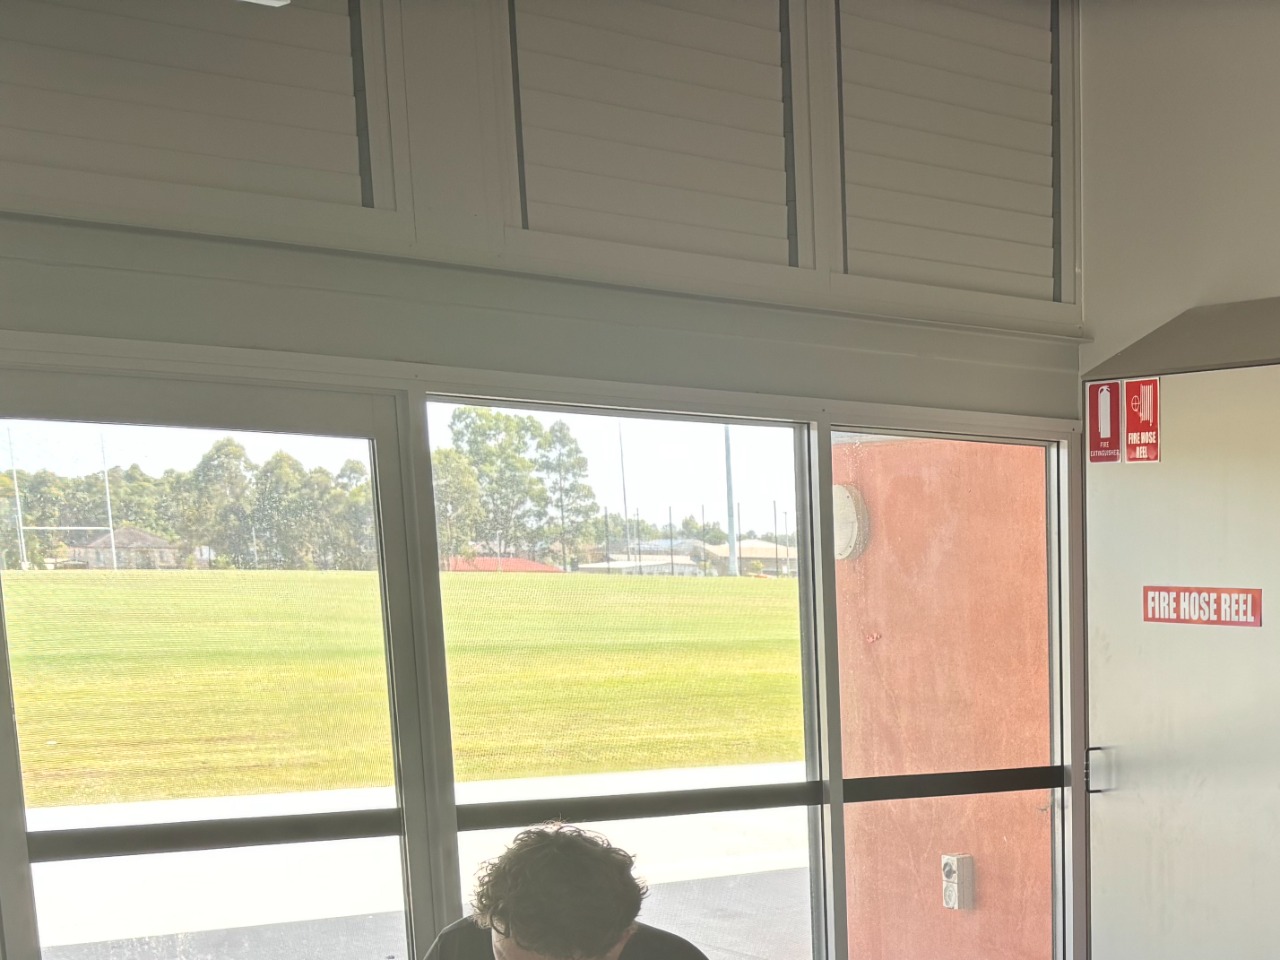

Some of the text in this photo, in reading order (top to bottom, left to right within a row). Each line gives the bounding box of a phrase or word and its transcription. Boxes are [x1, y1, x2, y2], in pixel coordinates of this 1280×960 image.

[1128, 431, 1157, 445] FIRE HOSE
[1090, 449, 1120, 457] EXTINGUISHER
[1136, 446, 1148, 459] REEL
[1147, 591, 1255, 622] FIRE HOSE REEL
